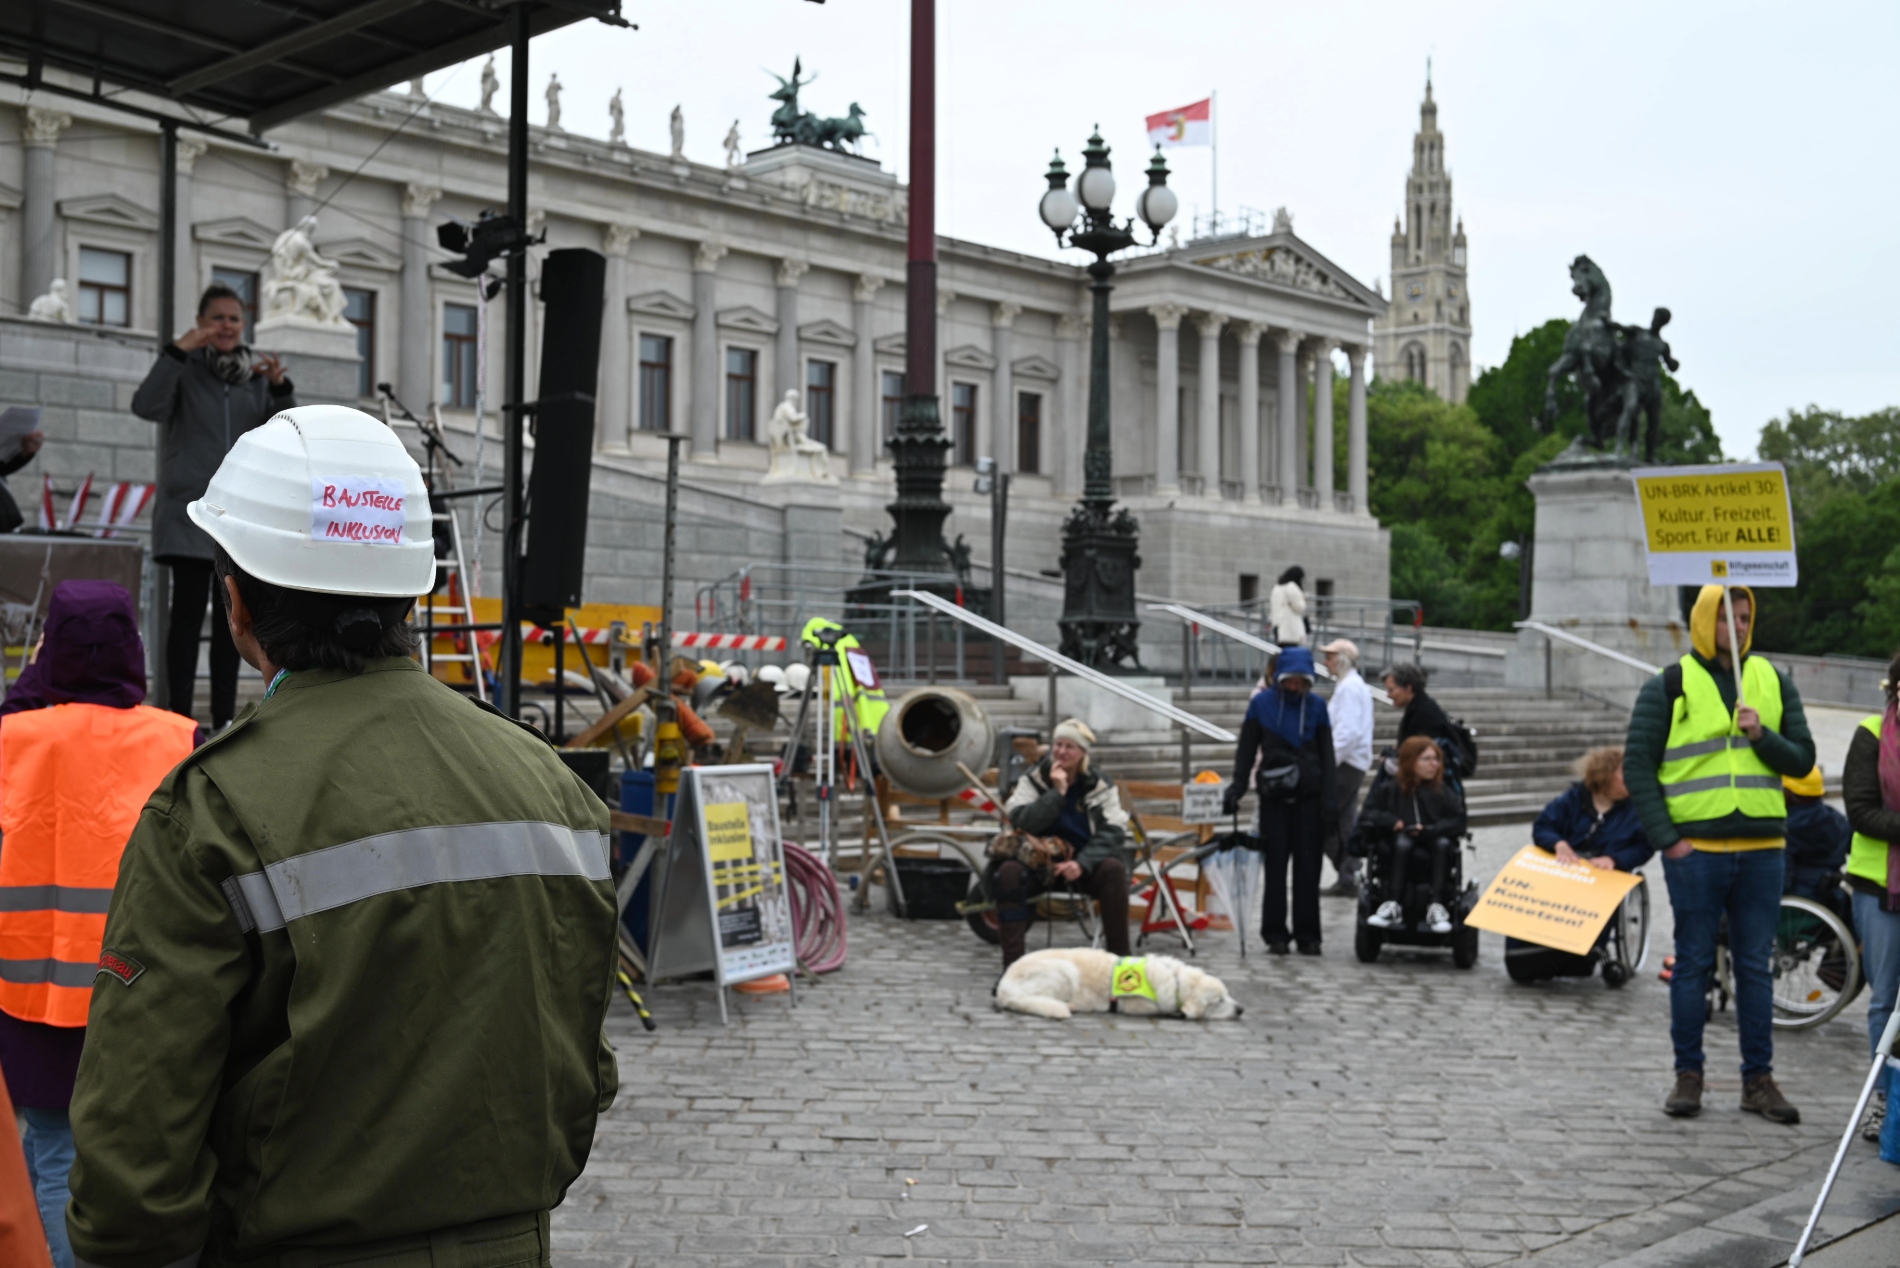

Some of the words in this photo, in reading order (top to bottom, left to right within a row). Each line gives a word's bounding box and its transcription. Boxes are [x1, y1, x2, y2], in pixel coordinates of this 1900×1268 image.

[322, 485, 404, 511] BAUSTELLE
[1645, 482, 1700, 499] UN-BRK
[1705, 480, 1751, 496] Artikel
[1754, 479, 1778, 496] 30:
[1658, 507, 1711, 523] Kultur.
[1713, 505, 1777, 522] Freizeit.
[325, 521, 403, 543] INKLUSION
[1655, 528, 1702, 547] Sport.
[1706, 527, 1731, 543] Für
[1735, 527, 1781, 543] ALLE!
[1486, 899, 1584, 929] umsetzen!
[1494, 887, 1600, 919] Konvention
